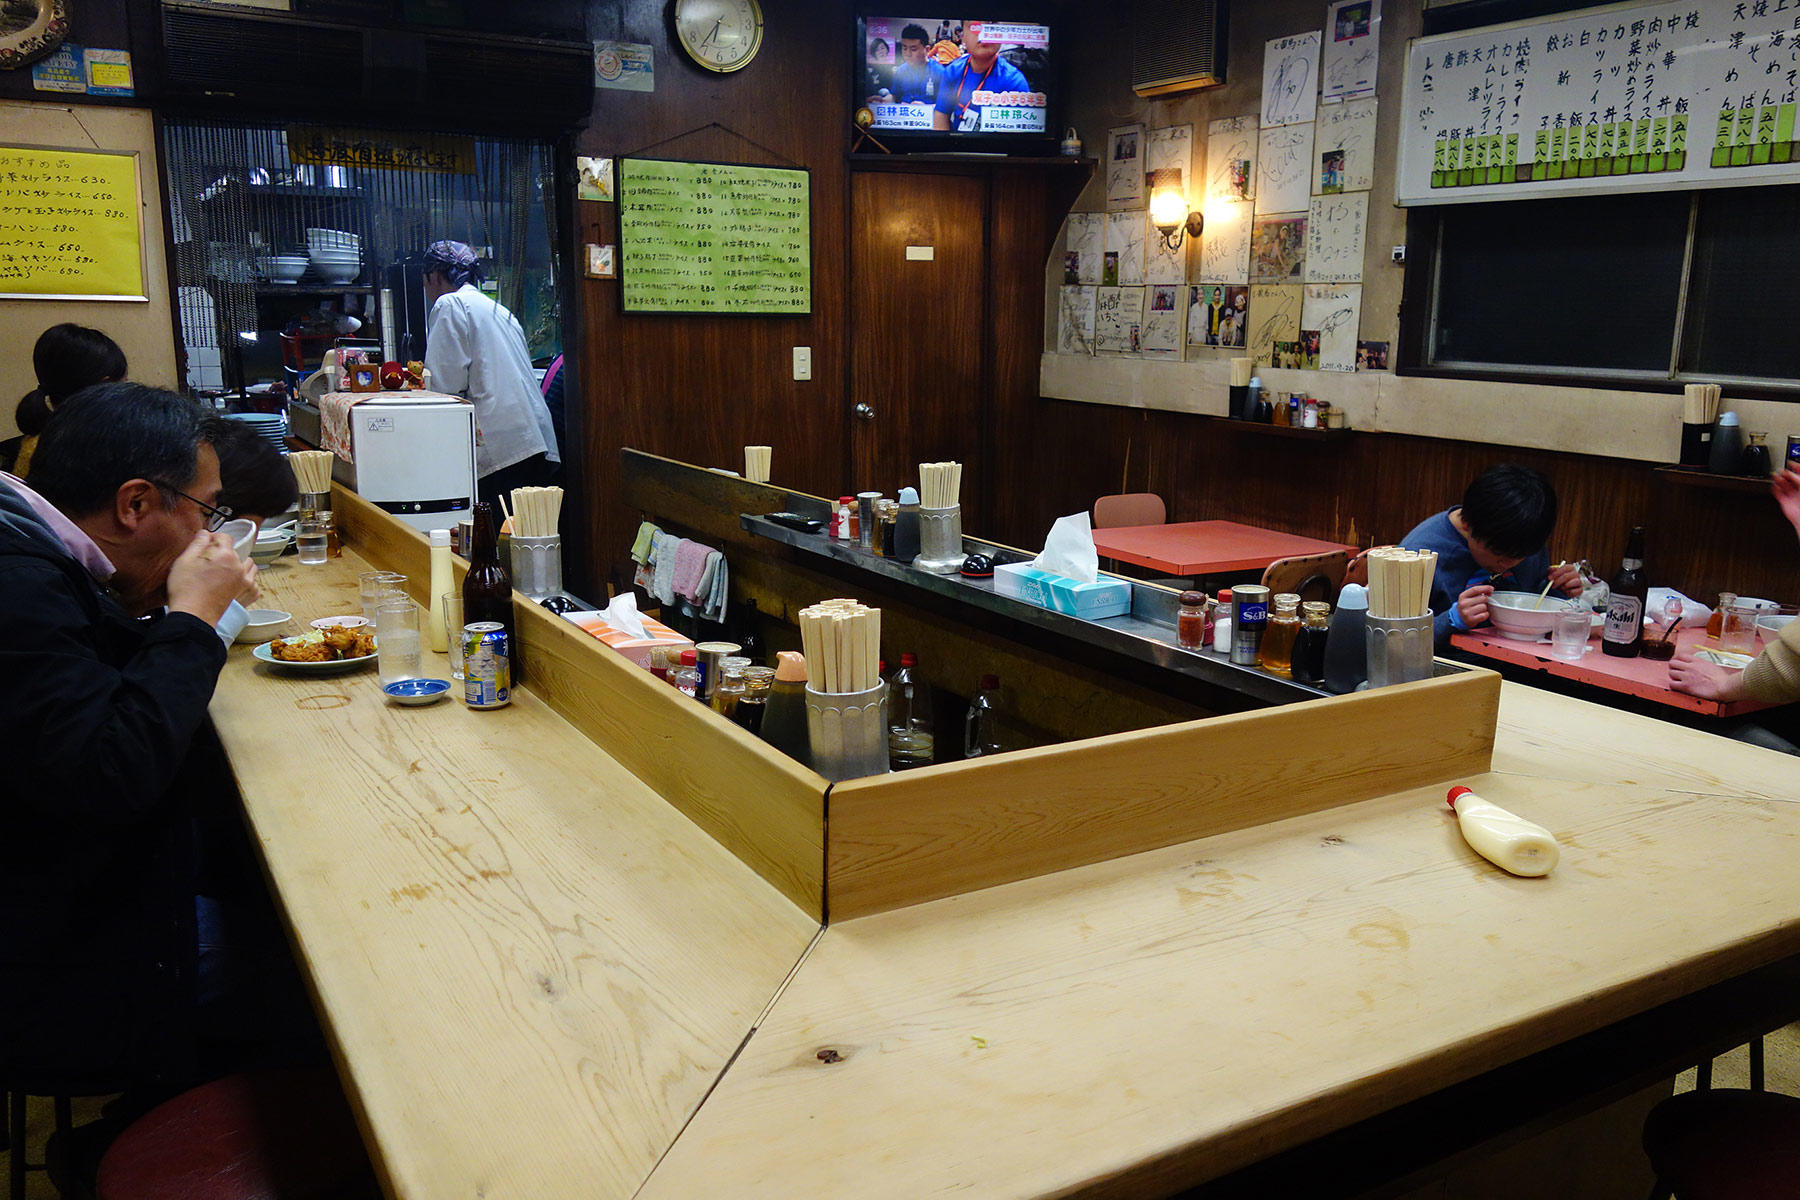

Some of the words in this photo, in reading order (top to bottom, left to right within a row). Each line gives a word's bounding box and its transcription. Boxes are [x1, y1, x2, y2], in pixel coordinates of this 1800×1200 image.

[1655, 14, 1683, 115] 中華丼
[1674, 9, 1701, 115] 焼飯
[1721, 3, 1748, 111] 天津めん
[1242, 611, 1266, 620] S&B
